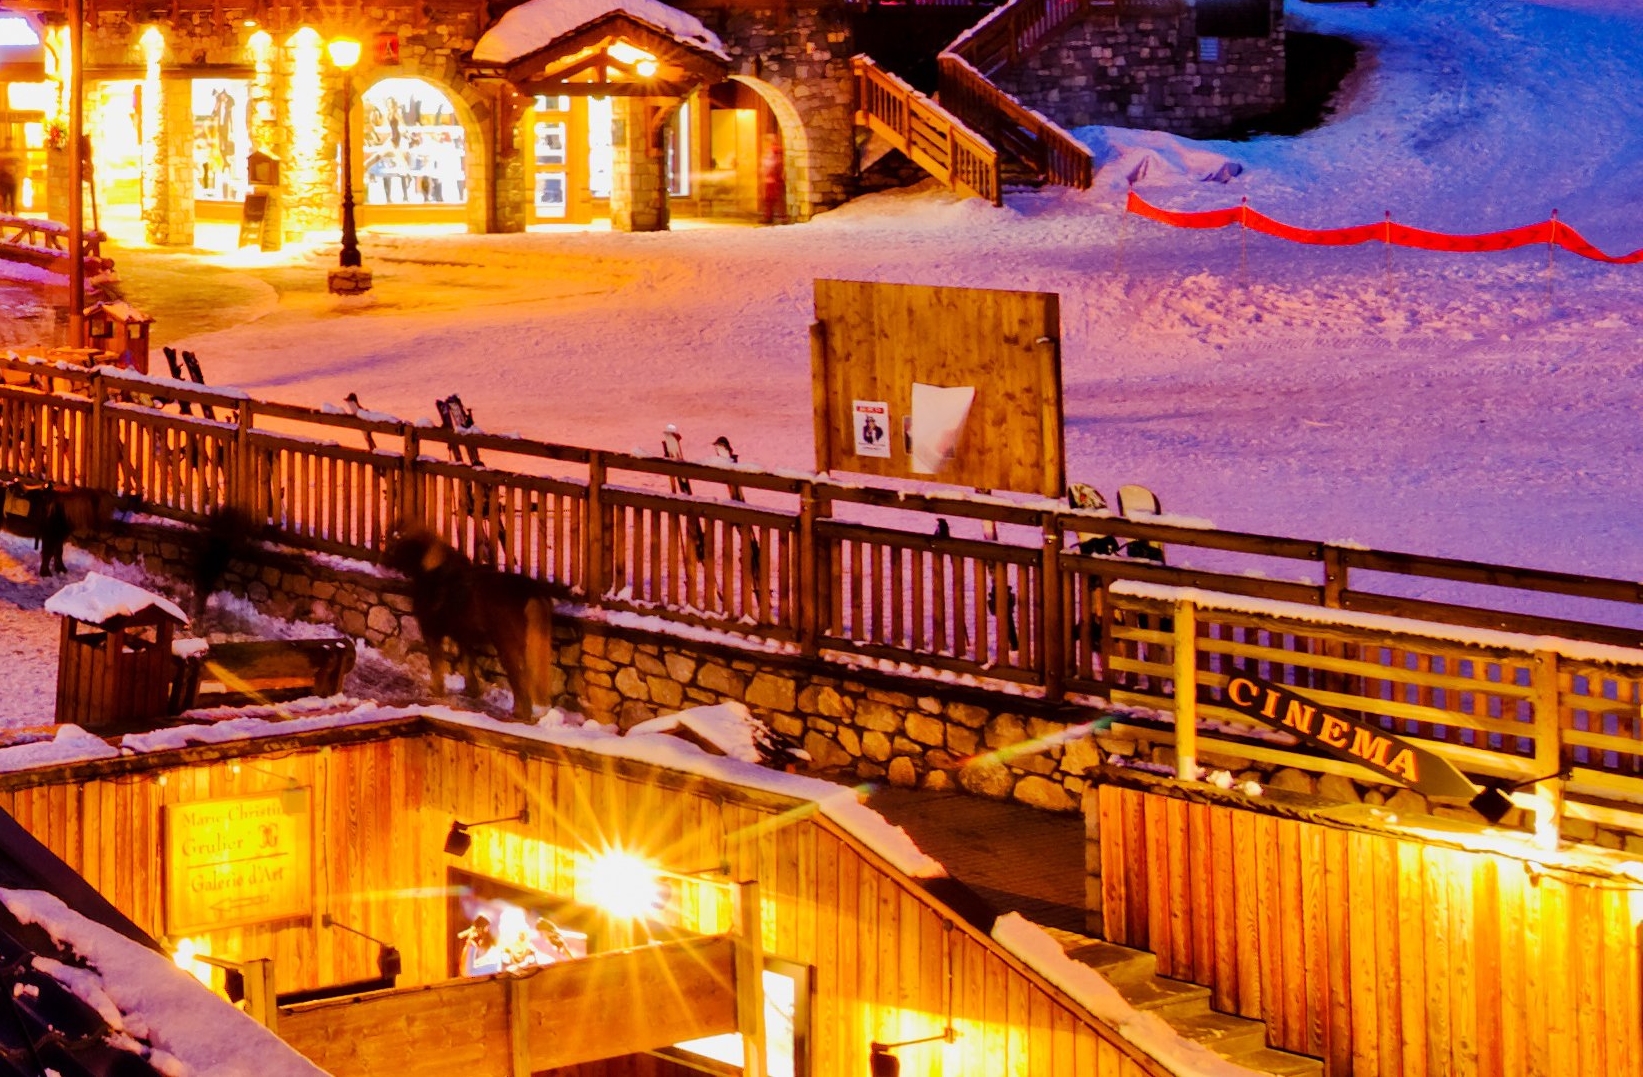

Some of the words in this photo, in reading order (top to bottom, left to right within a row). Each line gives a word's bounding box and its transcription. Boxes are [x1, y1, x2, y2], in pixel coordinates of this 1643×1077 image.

[1226, 676, 1421, 783] CINEMA
[191, 869, 244, 893] Galerie
[248, 864, 285, 885] d'Art
